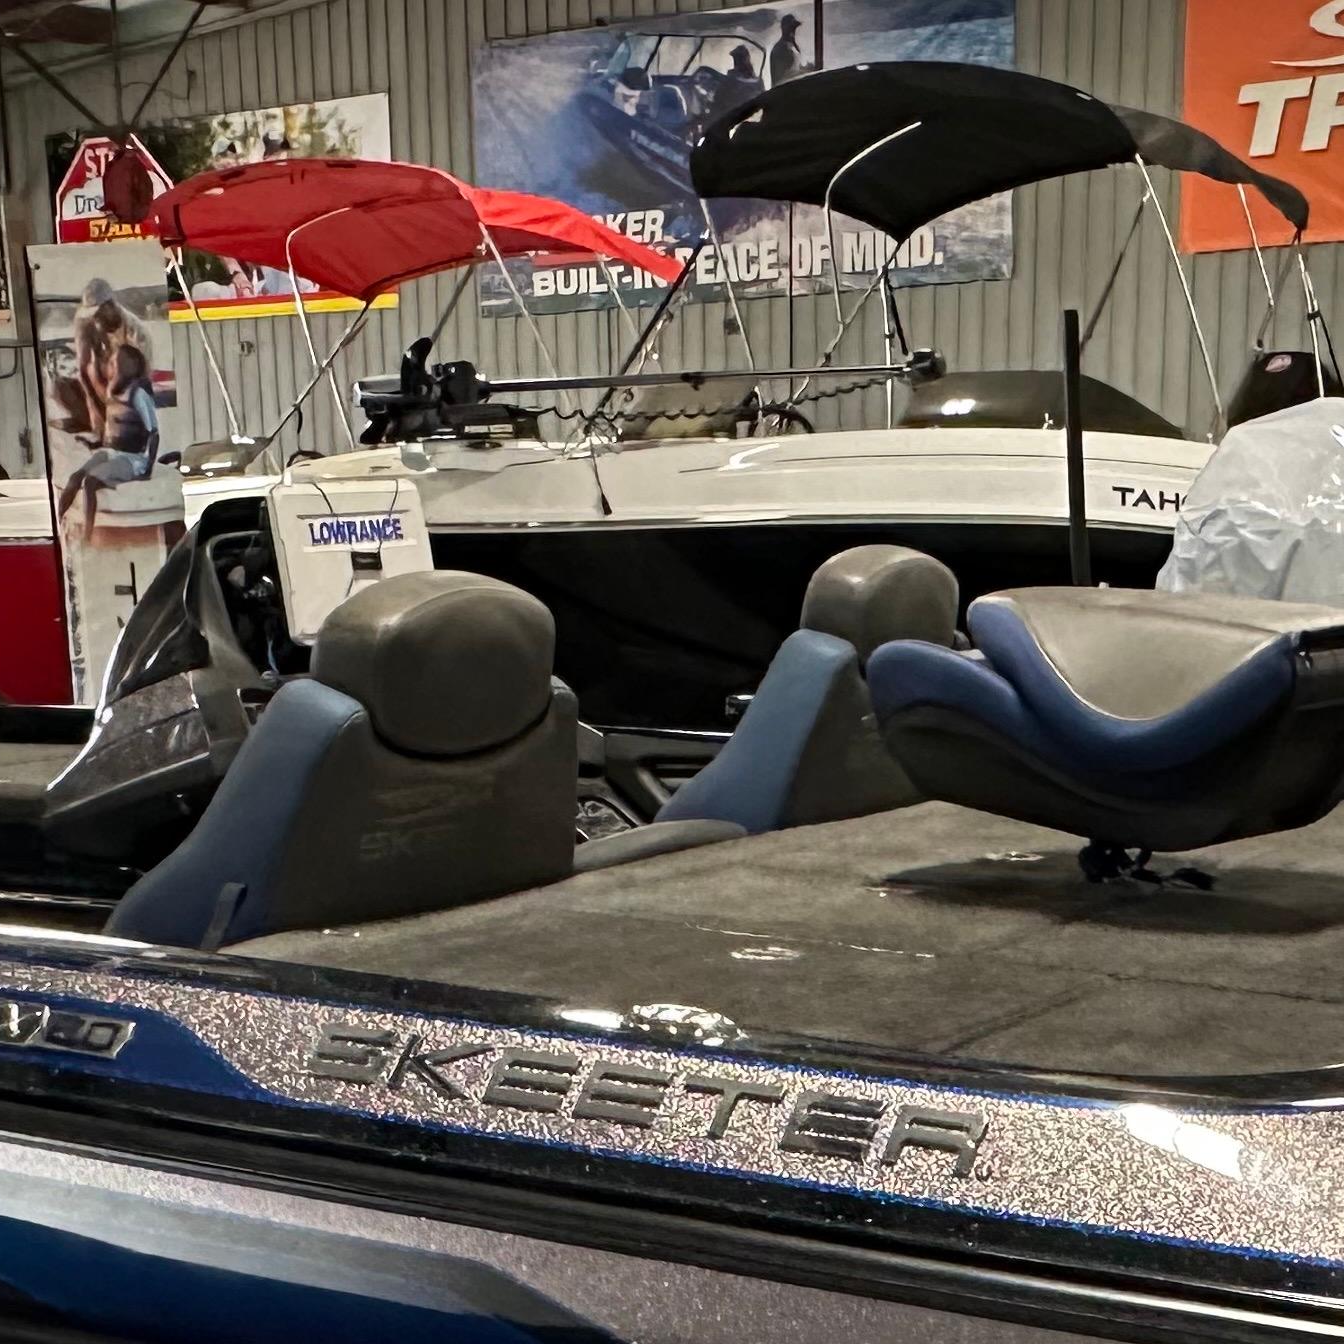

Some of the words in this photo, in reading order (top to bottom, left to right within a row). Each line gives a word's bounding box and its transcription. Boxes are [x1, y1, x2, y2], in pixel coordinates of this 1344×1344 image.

[84, 146, 115, 178] ST
[592, 209, 665, 243] KER
[792, 233, 832, 278] OF
[1112, 486, 1188, 512] TAH
[308, 518, 404, 546] LOWRANCE
[306, 1022, 989, 1178] SKEETER
